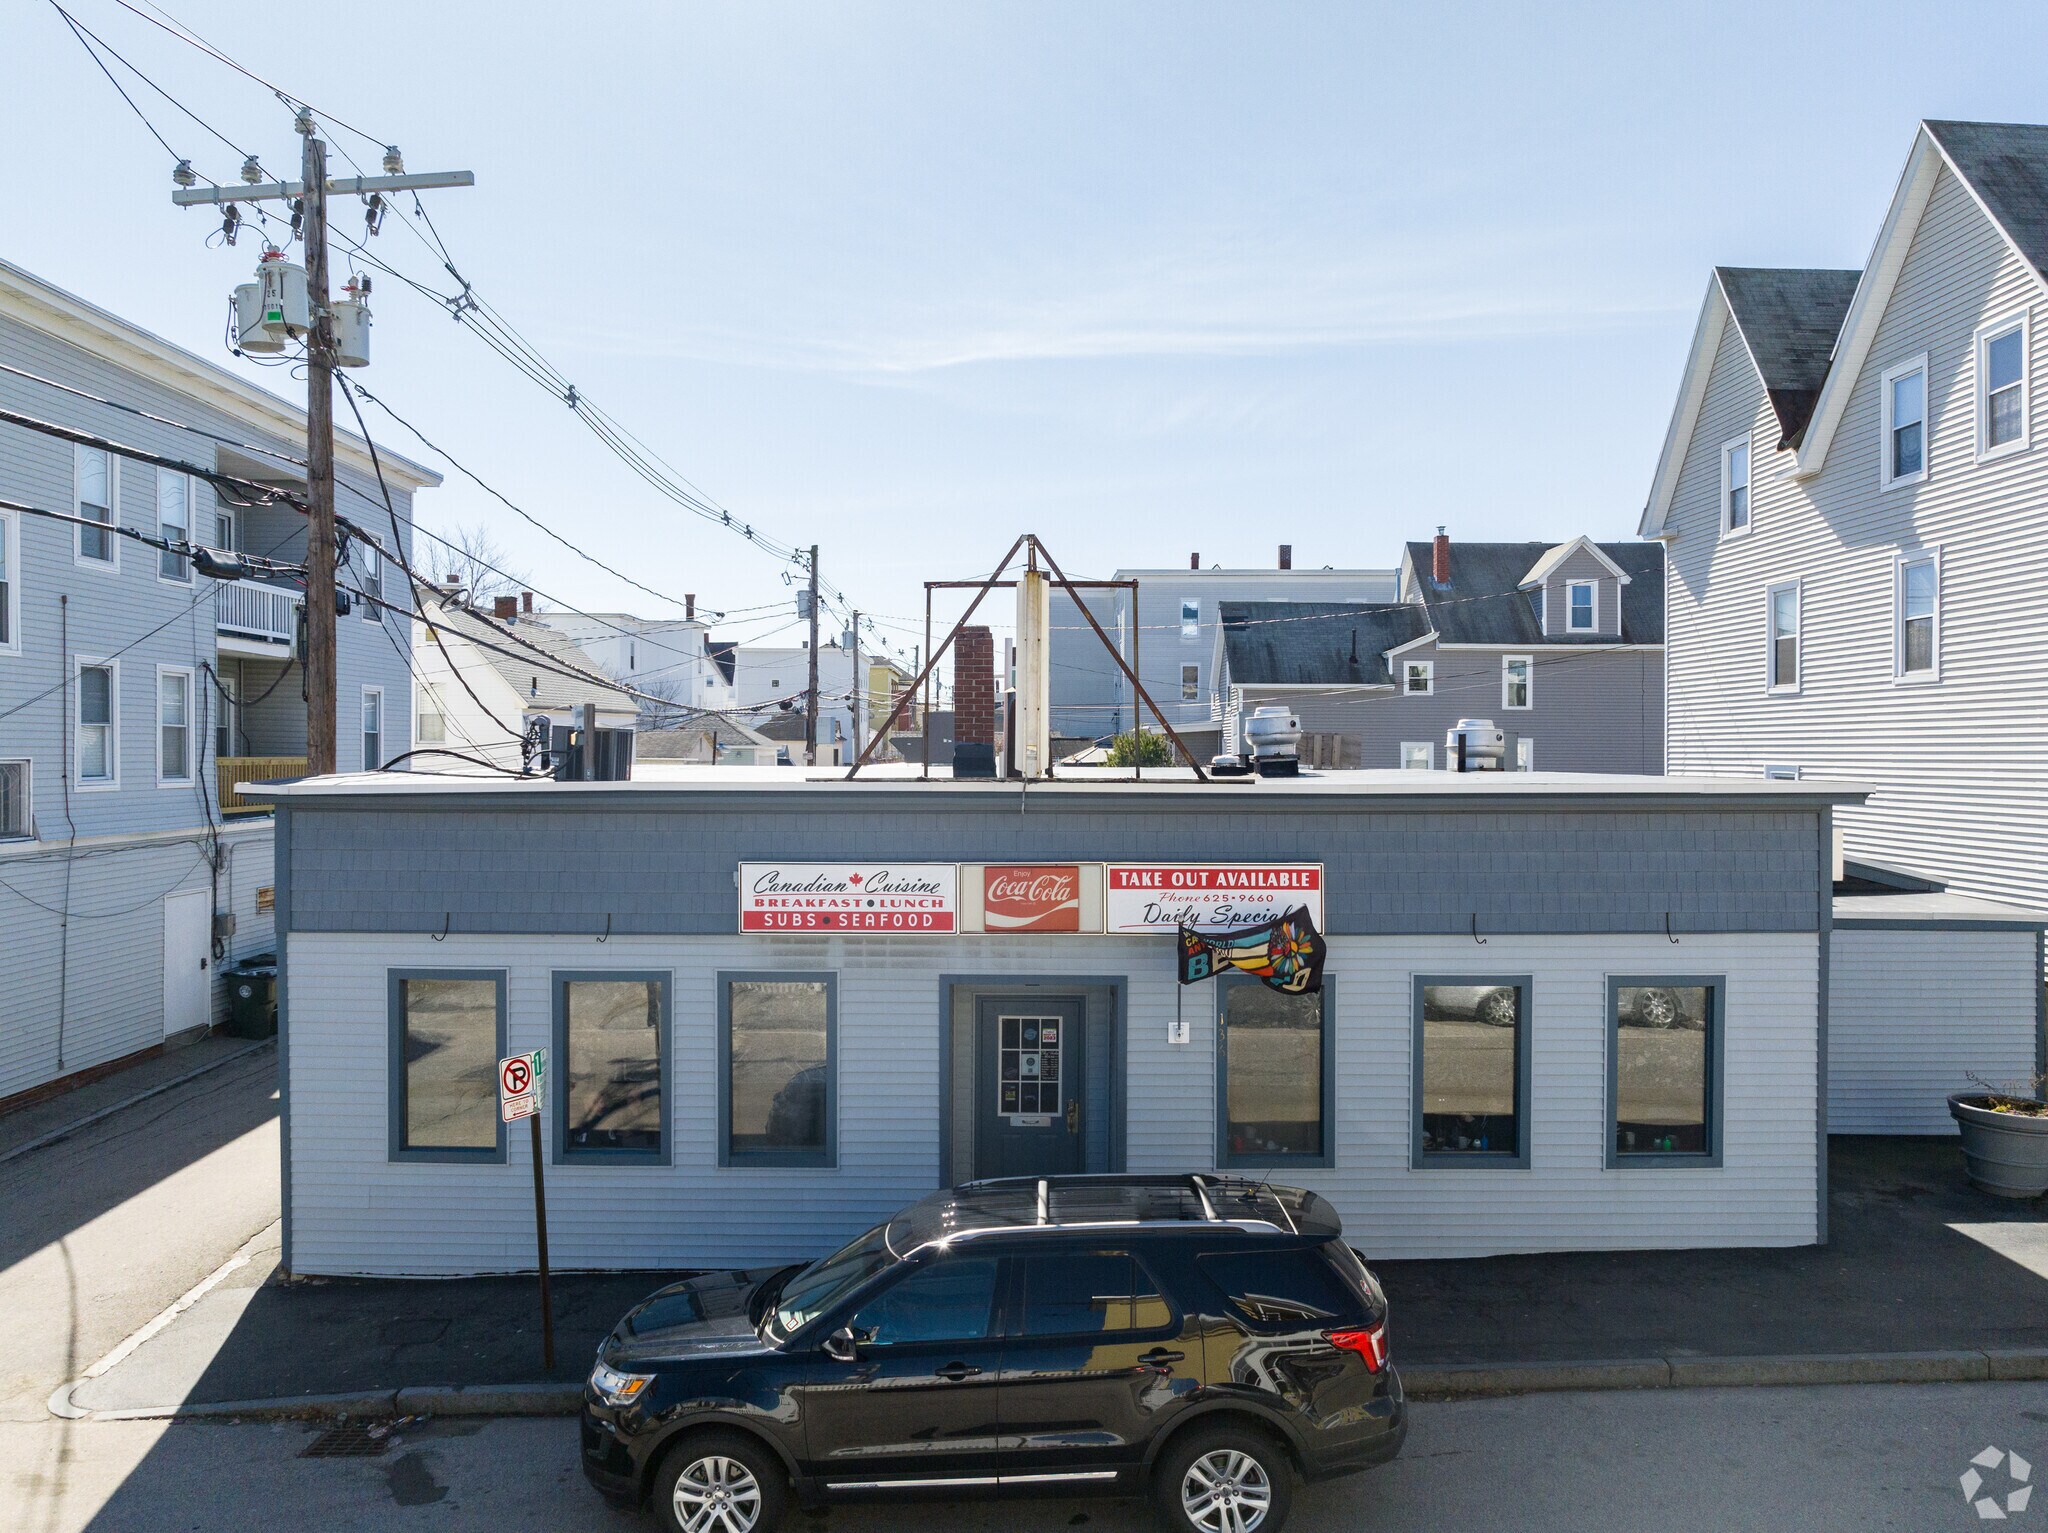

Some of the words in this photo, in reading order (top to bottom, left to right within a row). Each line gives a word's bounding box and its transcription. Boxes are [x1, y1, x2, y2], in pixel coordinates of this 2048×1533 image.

[267, 290, 276, 298] 25
[753, 870, 849, 894] Canadian
[864, 870, 941, 894] Cuisine
[1119, 871, 1163, 887] TAKE
[1171, 871, 1209, 887] OUT
[1216, 871, 1310, 887] AVAILABLE
[987, 874, 1073, 902] Coca-Cola
[754, 898, 863, 908] BREAKFAST
[879, 898, 944, 908] LUNCH
[1159, 892, 1200, 903] Phone
[1203, 894, 1274, 903] 625-9660
[764, 913, 816, 927] SUBS
[838, 913, 933, 927] SEAFOOD
[1143, 903, 1200, 929] Daily
